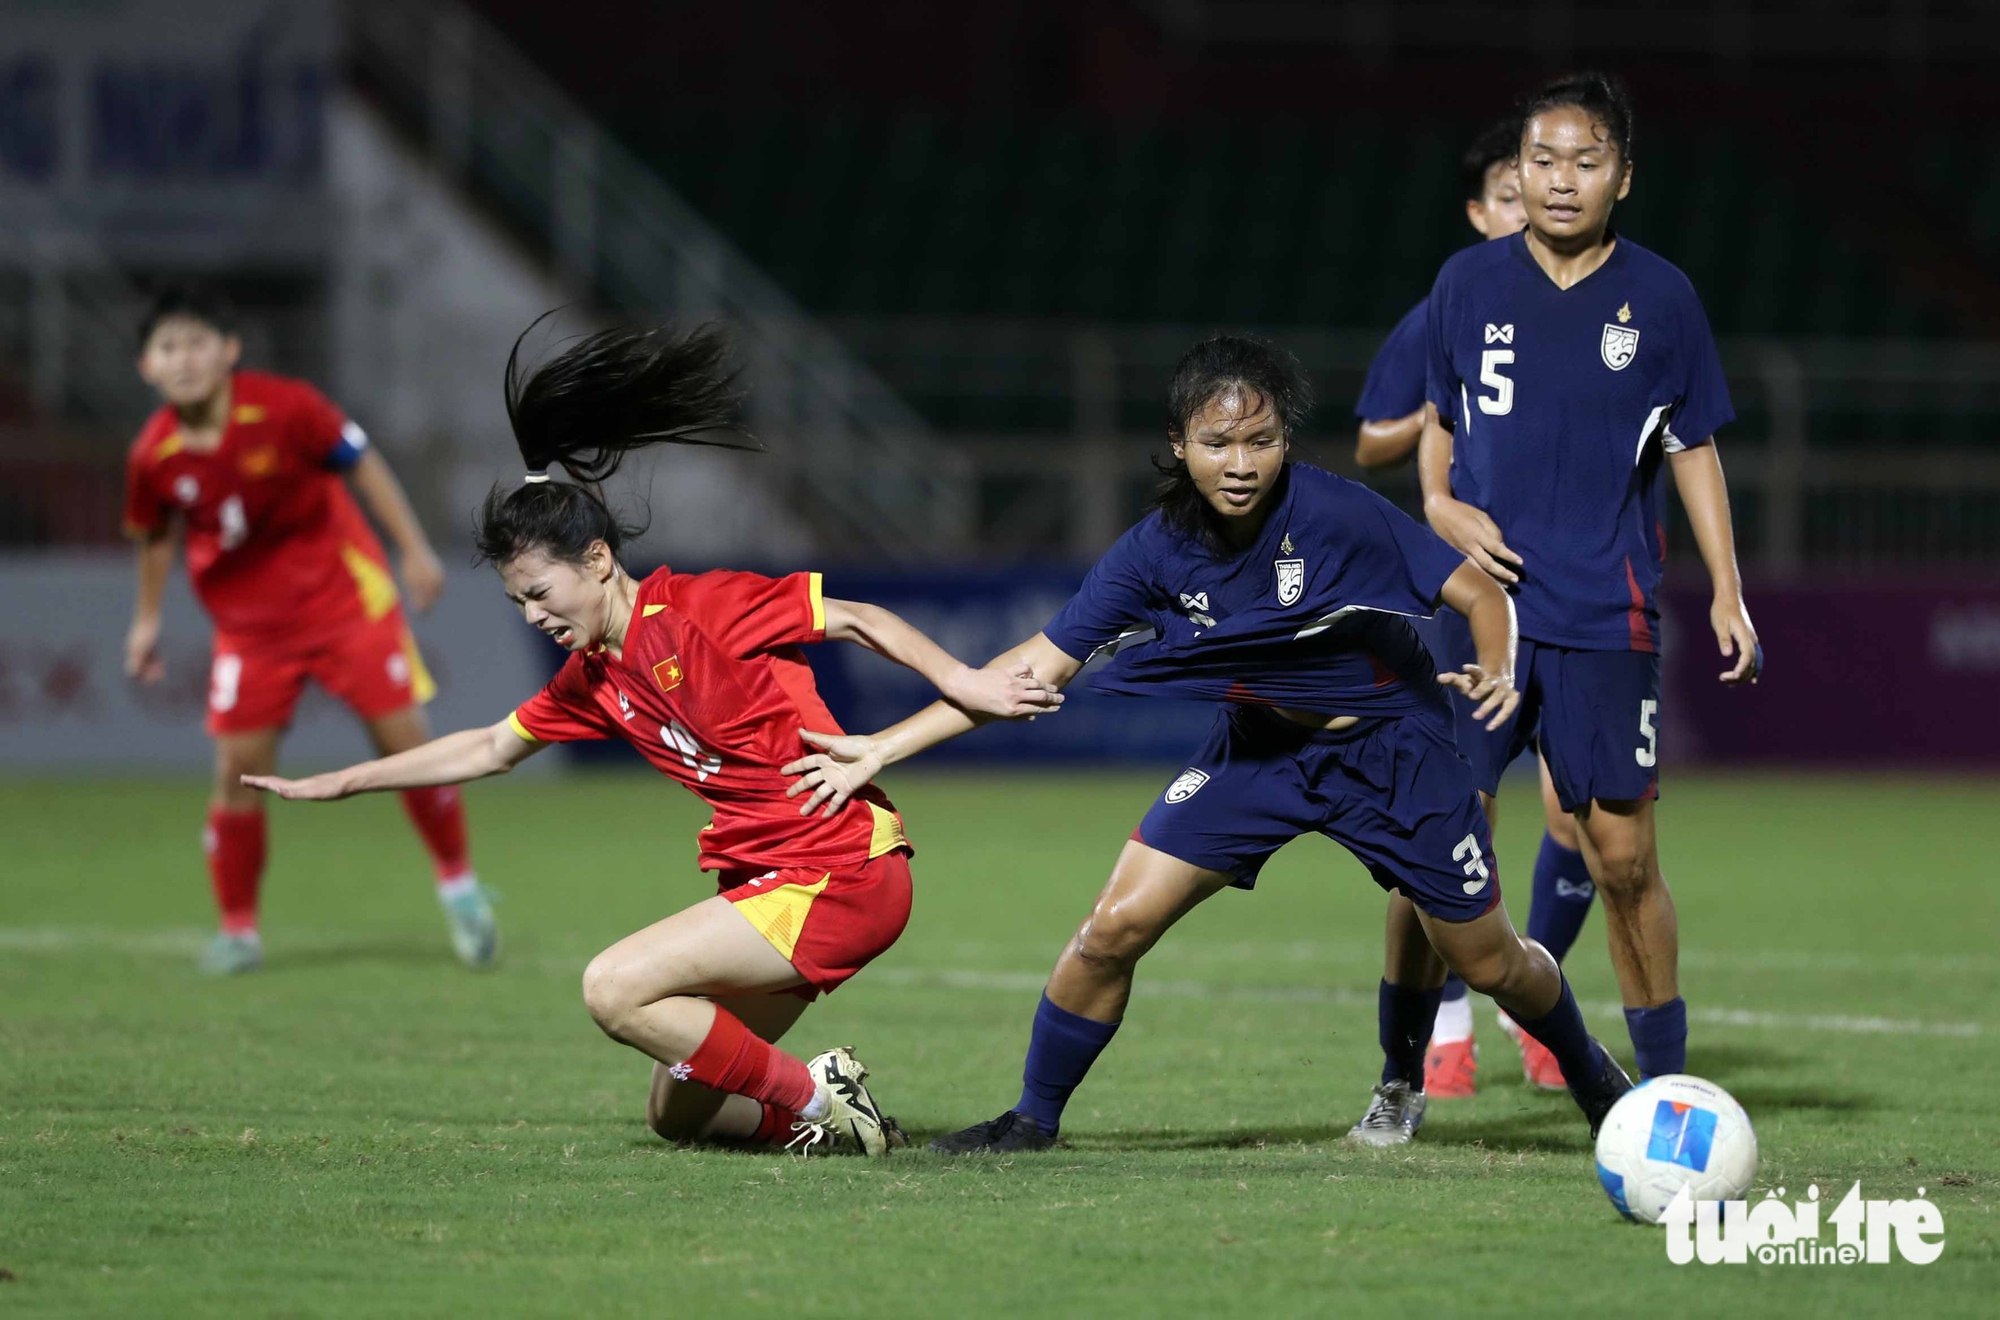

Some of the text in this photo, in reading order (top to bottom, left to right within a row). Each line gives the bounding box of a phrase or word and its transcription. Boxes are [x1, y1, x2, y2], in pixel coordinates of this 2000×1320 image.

[1477, 349, 1515, 416] 5
[1635, 699, 1657, 767] 5
[1452, 833, 1490, 895] 3
